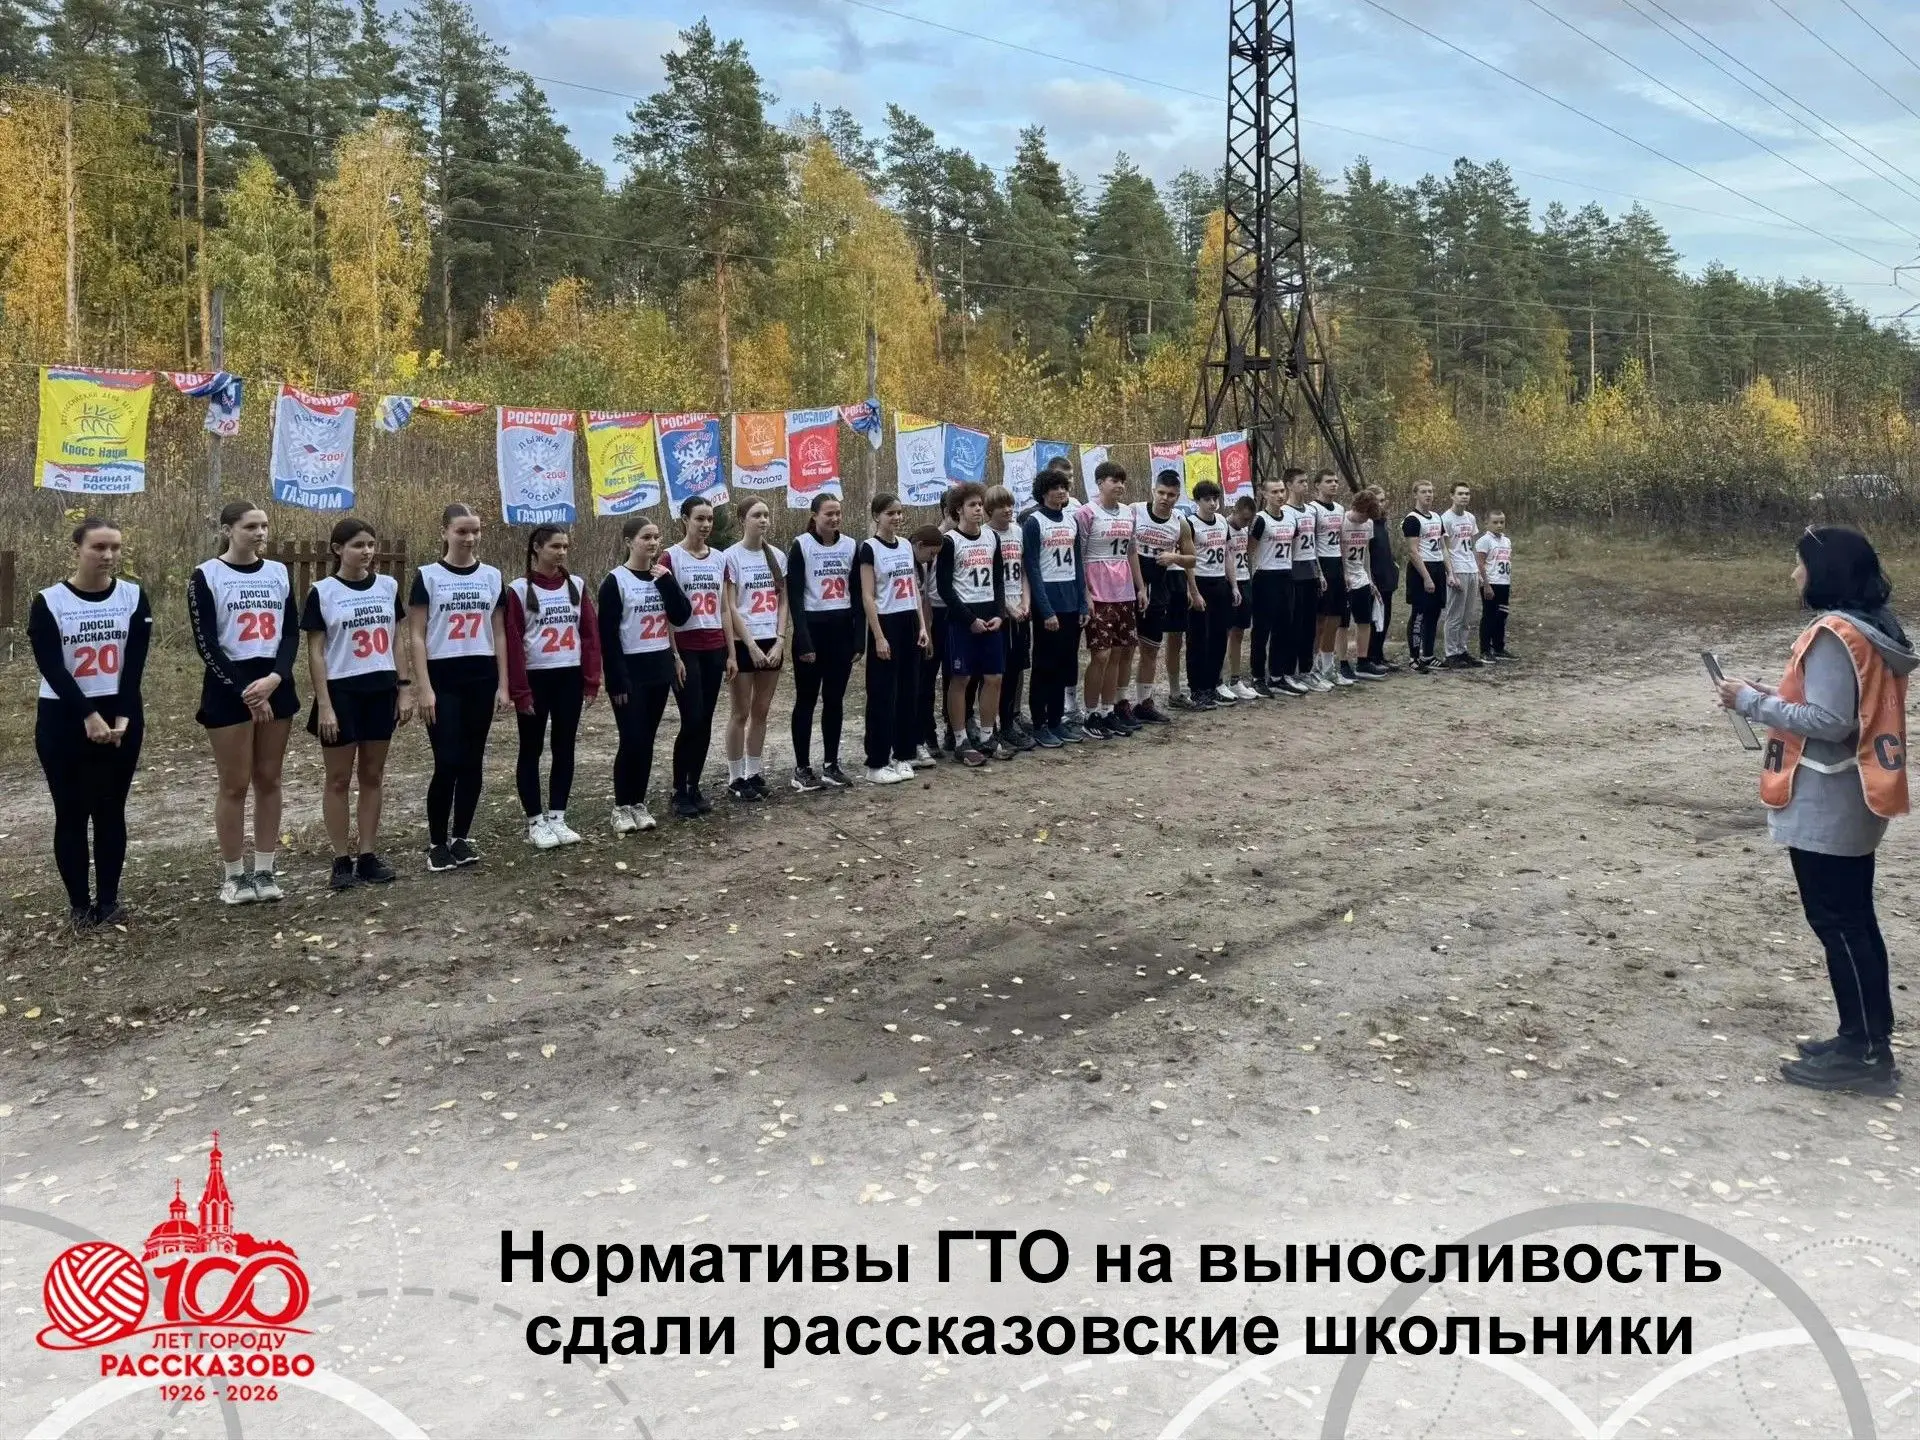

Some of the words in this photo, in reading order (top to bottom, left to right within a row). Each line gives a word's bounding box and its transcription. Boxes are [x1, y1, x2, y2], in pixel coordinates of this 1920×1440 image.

[507, 410, 575, 426] РОССПОРТ
[518, 435, 561, 450] ЛЫЖНЯ
[83, 474, 132, 483] ЕДИНАЯ
[83, 483, 130, 491] РОССИЯ
[521, 486, 562, 501] РОССИИ
[1110, 538, 1129, 555] 13
[1275, 543, 1291, 558] 27
[1348, 546, 1365, 560] 21
[1052, 547, 1073, 567] 14
[1206, 547, 1224, 565] 26
[693, 573, 714, 582] ДЮСШ
[969, 567, 991, 587] 12
[1003, 562, 1020, 581] 18
[240, 590, 270, 600] ДЮСШ
[452, 592, 480, 601] ДЮСШ
[821, 577, 846, 600] 29
[893, 577, 914, 600] 21
[227, 600, 282, 611] РАССКАЗОВО
[440, 601, 491, 612] РАССКАЗОВО
[691, 592, 717, 616] 26
[751, 590, 777, 613] 25
[354, 605, 383, 617] ДЮСШ
[546, 605, 571, 616] ДЮСШ
[79, 619, 115, 632] ДЮСШ
[237, 612, 276, 641] 28
[448, 612, 482, 640] 27
[640, 614, 668, 640] 22
[63, 630, 127, 645] РАССКАЗОВО
[352, 627, 389, 658] 30
[541, 625, 576, 652] 24
[73, 644, 120, 677] 20
